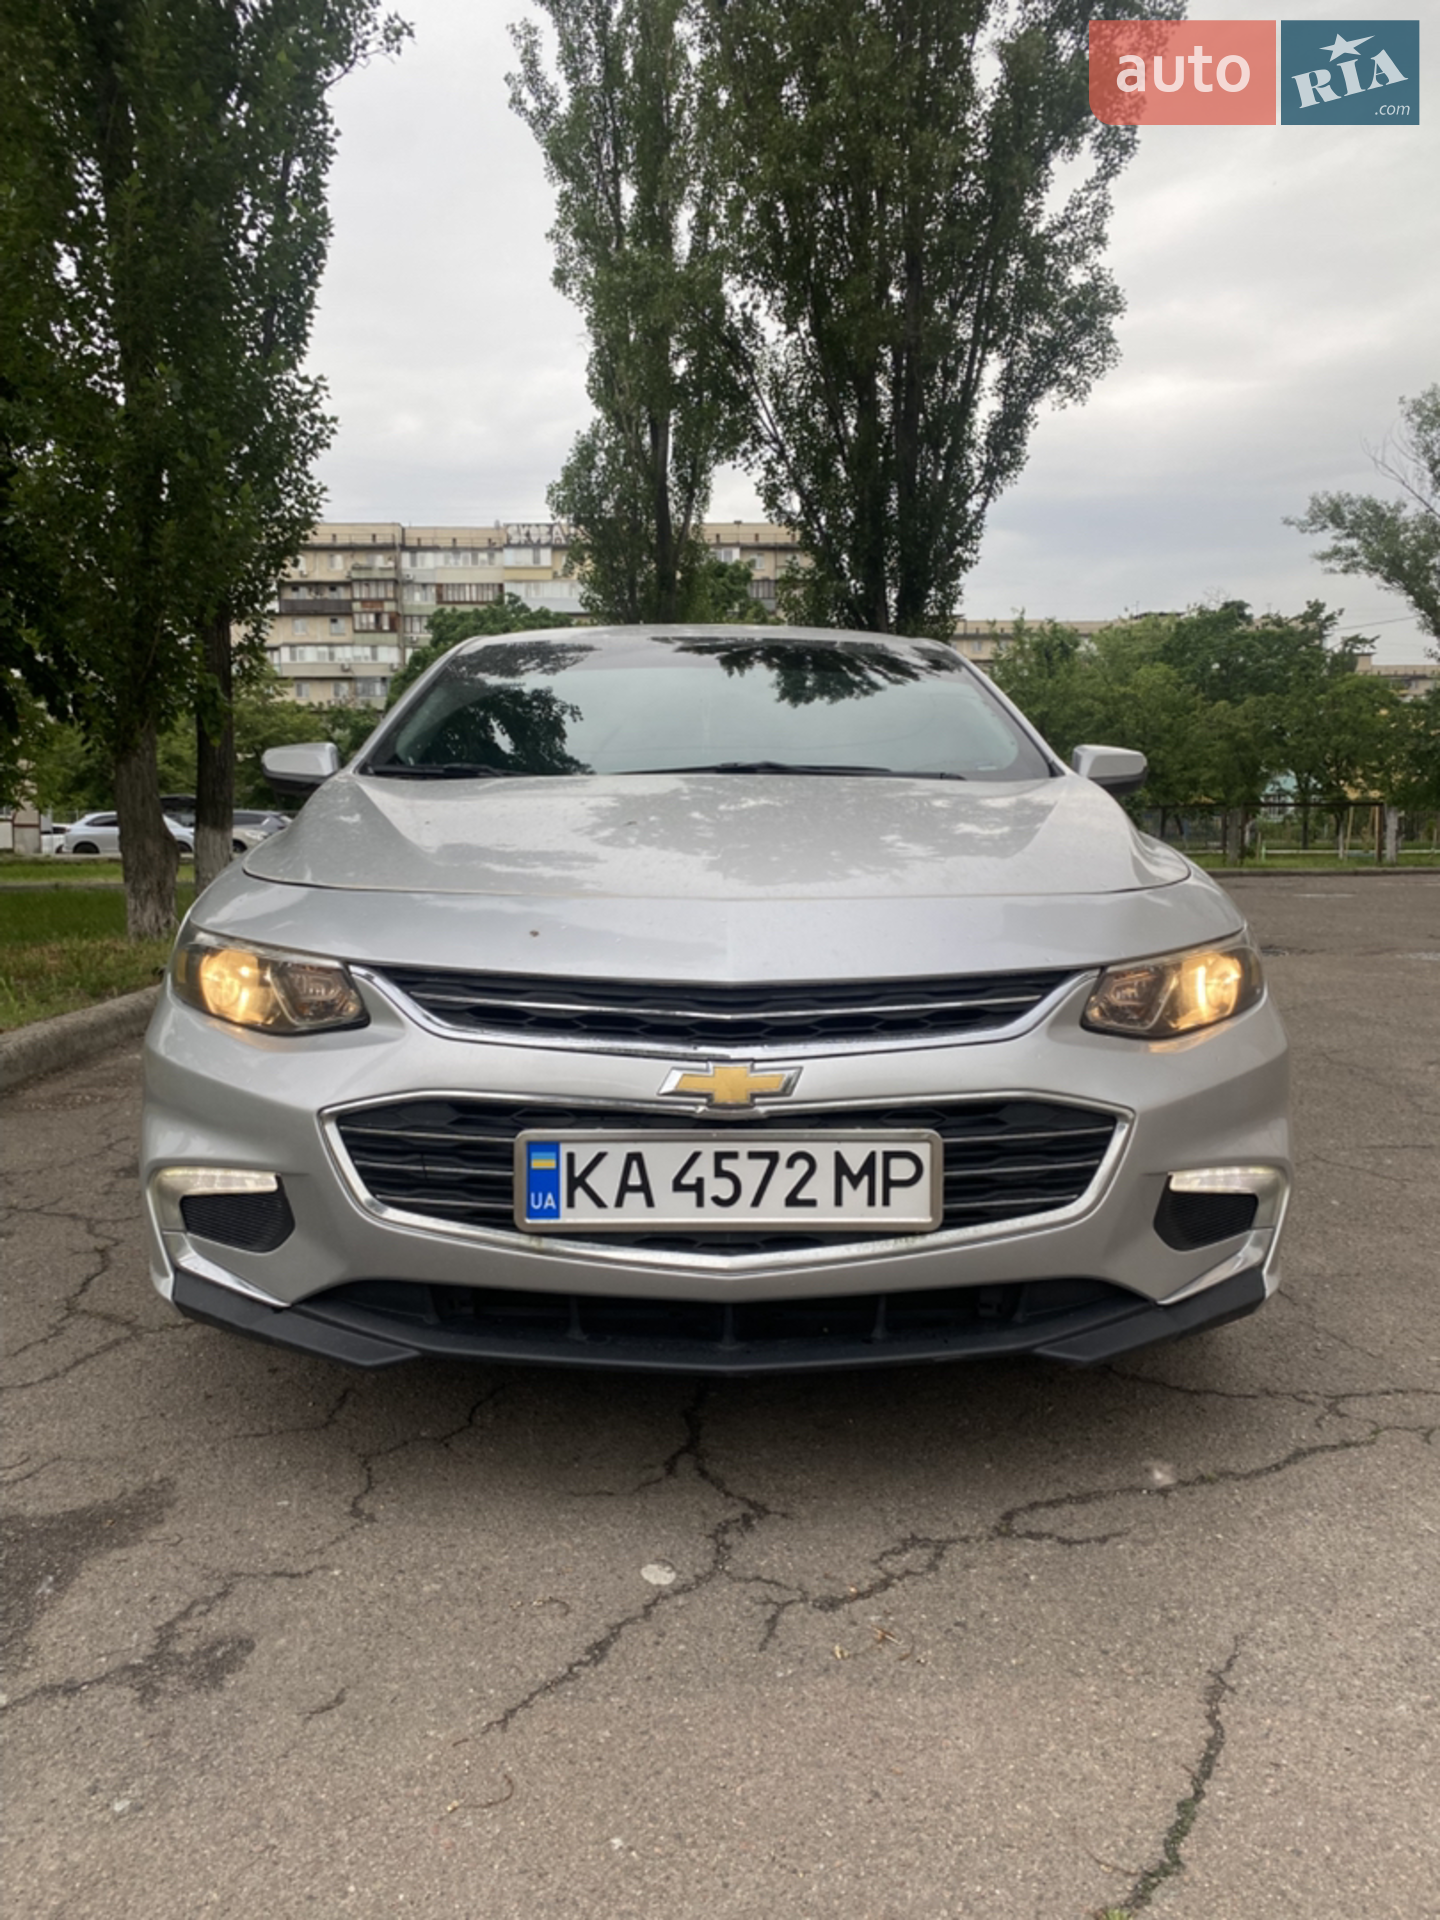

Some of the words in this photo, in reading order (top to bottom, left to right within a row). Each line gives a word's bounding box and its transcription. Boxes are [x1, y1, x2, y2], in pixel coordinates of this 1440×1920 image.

[566, 1151, 655, 1208] KA
[672, 1150, 818, 1208] 4572
[834, 1150, 924, 1208] MP
[530, 1192, 557, 1210] UA
